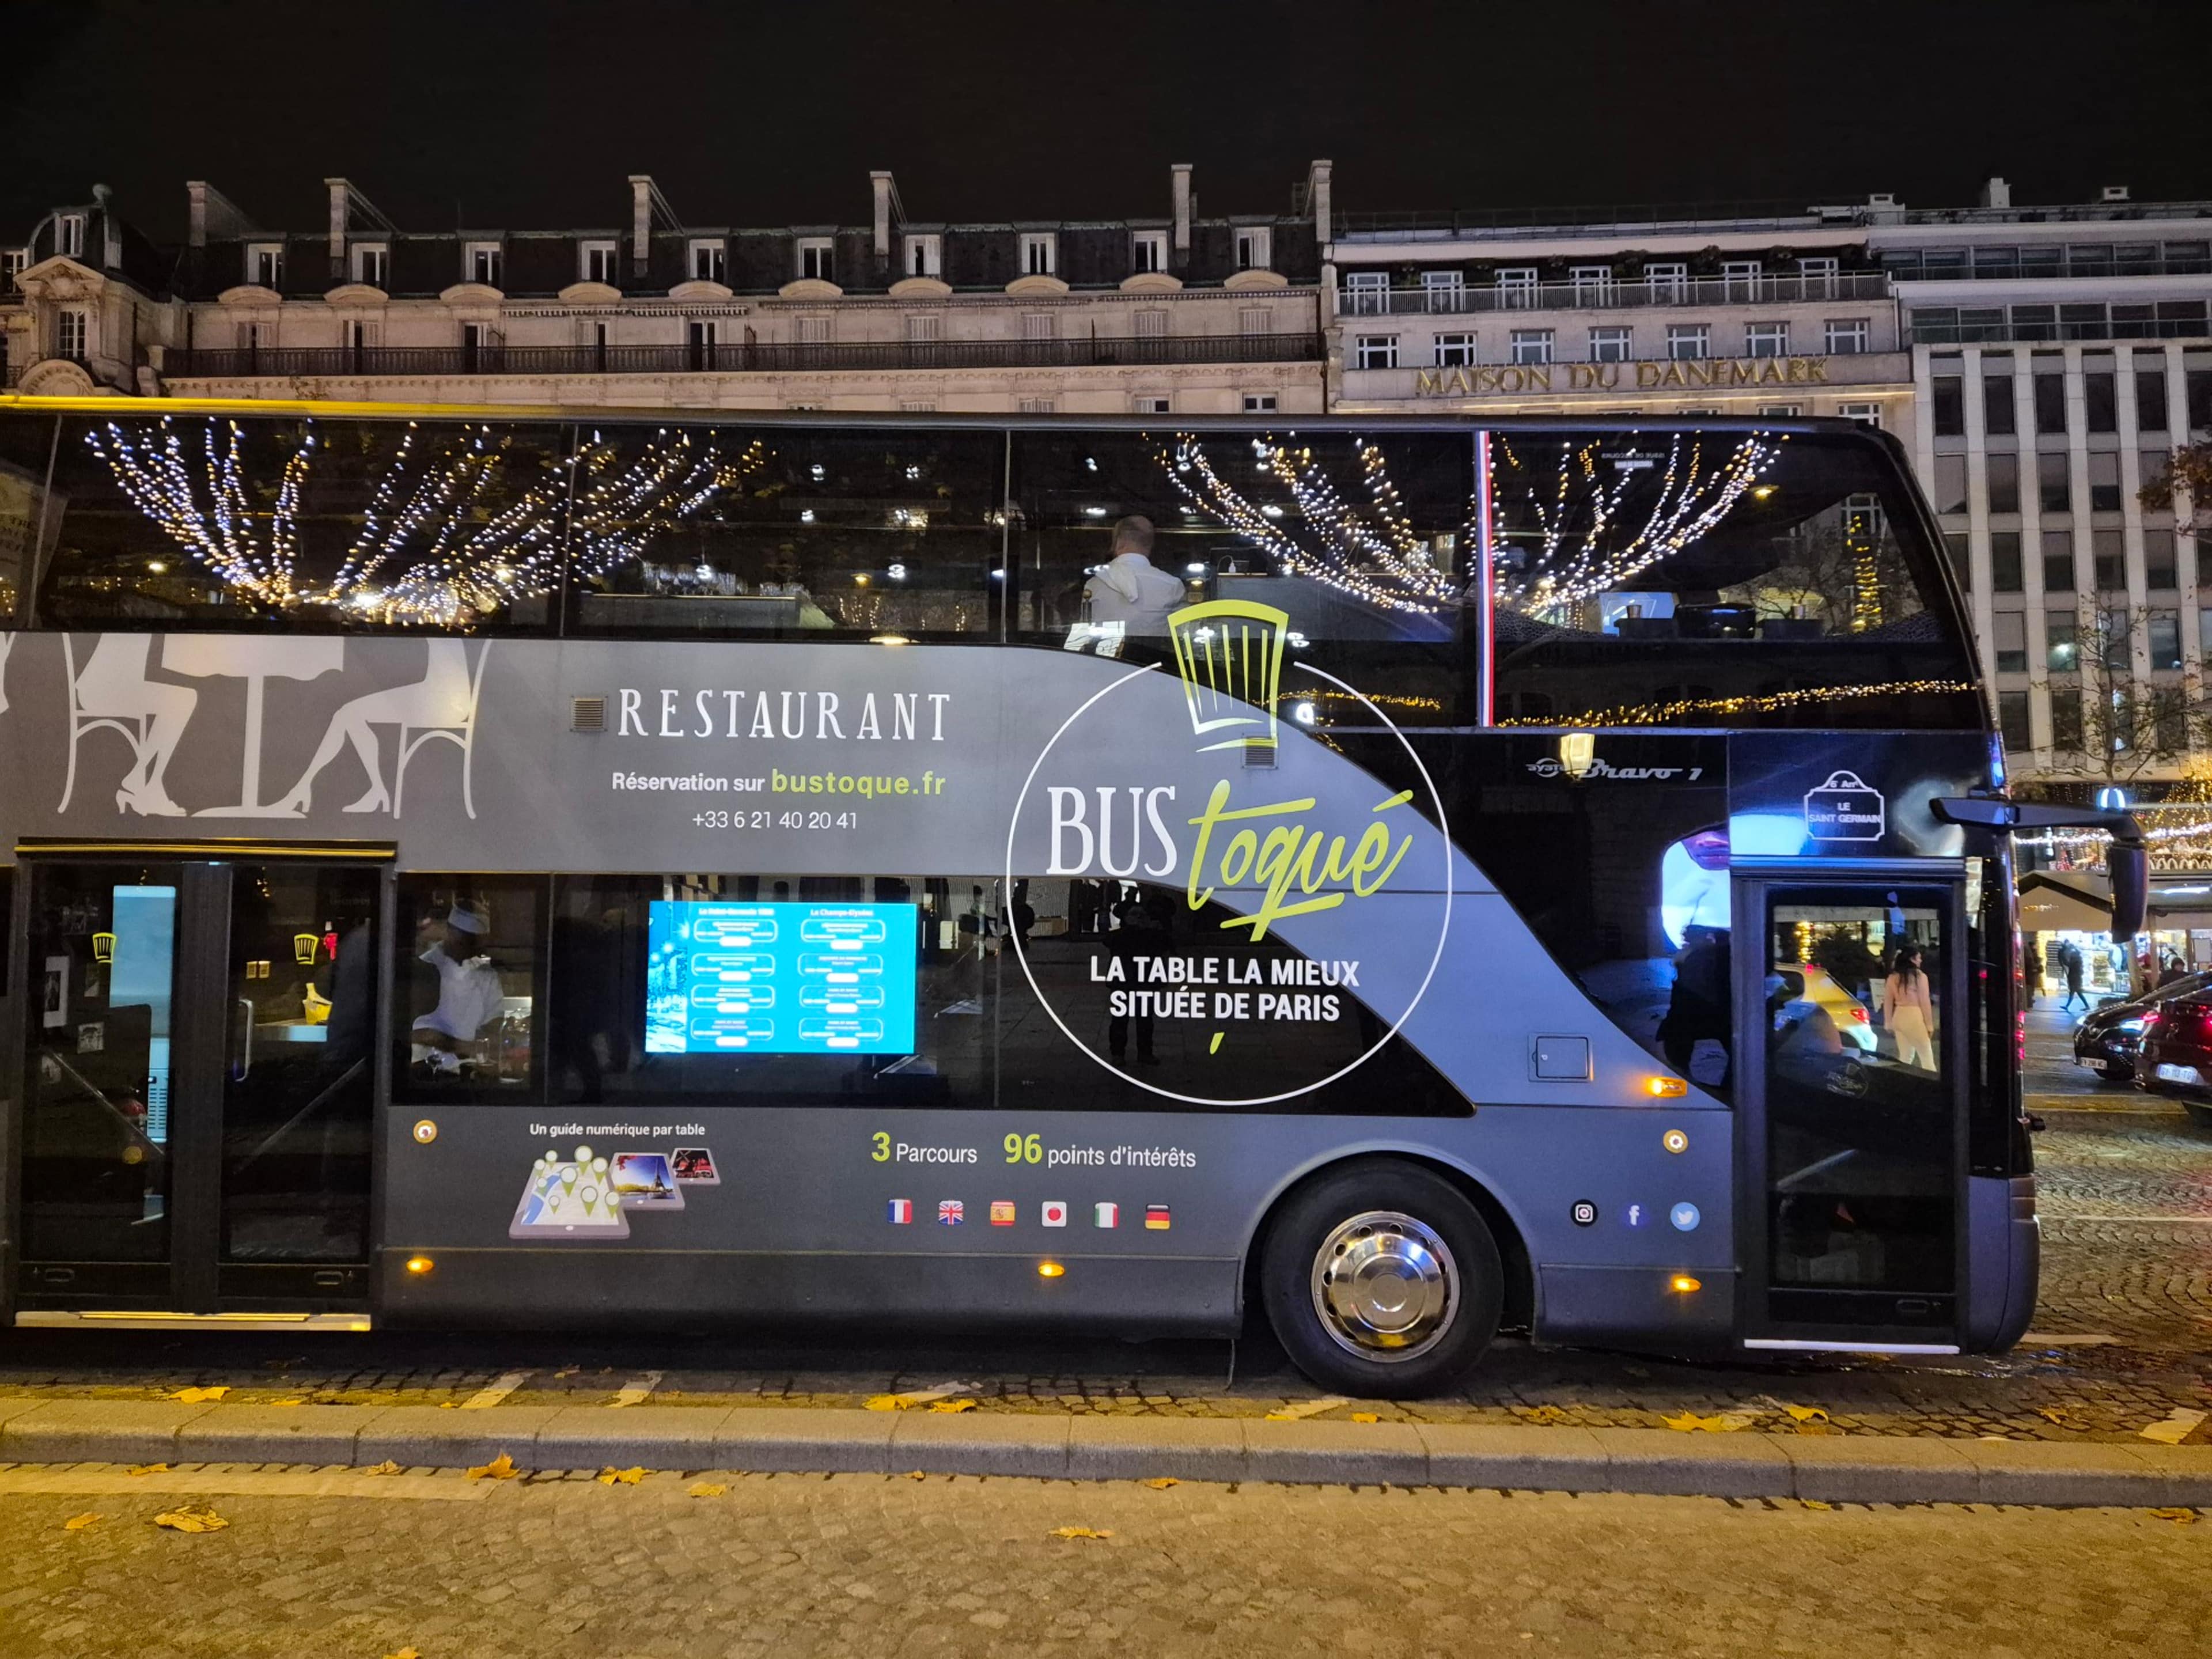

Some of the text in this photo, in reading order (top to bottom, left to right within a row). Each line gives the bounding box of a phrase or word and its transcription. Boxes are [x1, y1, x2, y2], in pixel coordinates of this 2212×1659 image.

[1415, 356, 1828, 395] MAISON DU DANEMARK
[618, 688, 951, 741] RESTAURANT
[612, 768, 946, 800] Réservation sur bustoque.fr
[1578, 757, 1683, 779] Bravo
[692, 810, 857, 829] +33 6 21 40 20 41
[1809, 814, 1881, 823] SAINT GERMAIN
[1836, 802, 1851, 811] LE
[1045, 779, 1414, 942] BUS toqué
[1090, 955, 1360, 987] LA TABLE LA MIEUX
[1109, 984, 1340, 1022] SITUÉE DE PARIS
[529, 1123, 706, 1138] Un guide numérique par table
[871, 1131, 978, 1164] 3 Parcours
[1003, 1132, 1196, 1169] 96 points d'intérêts
